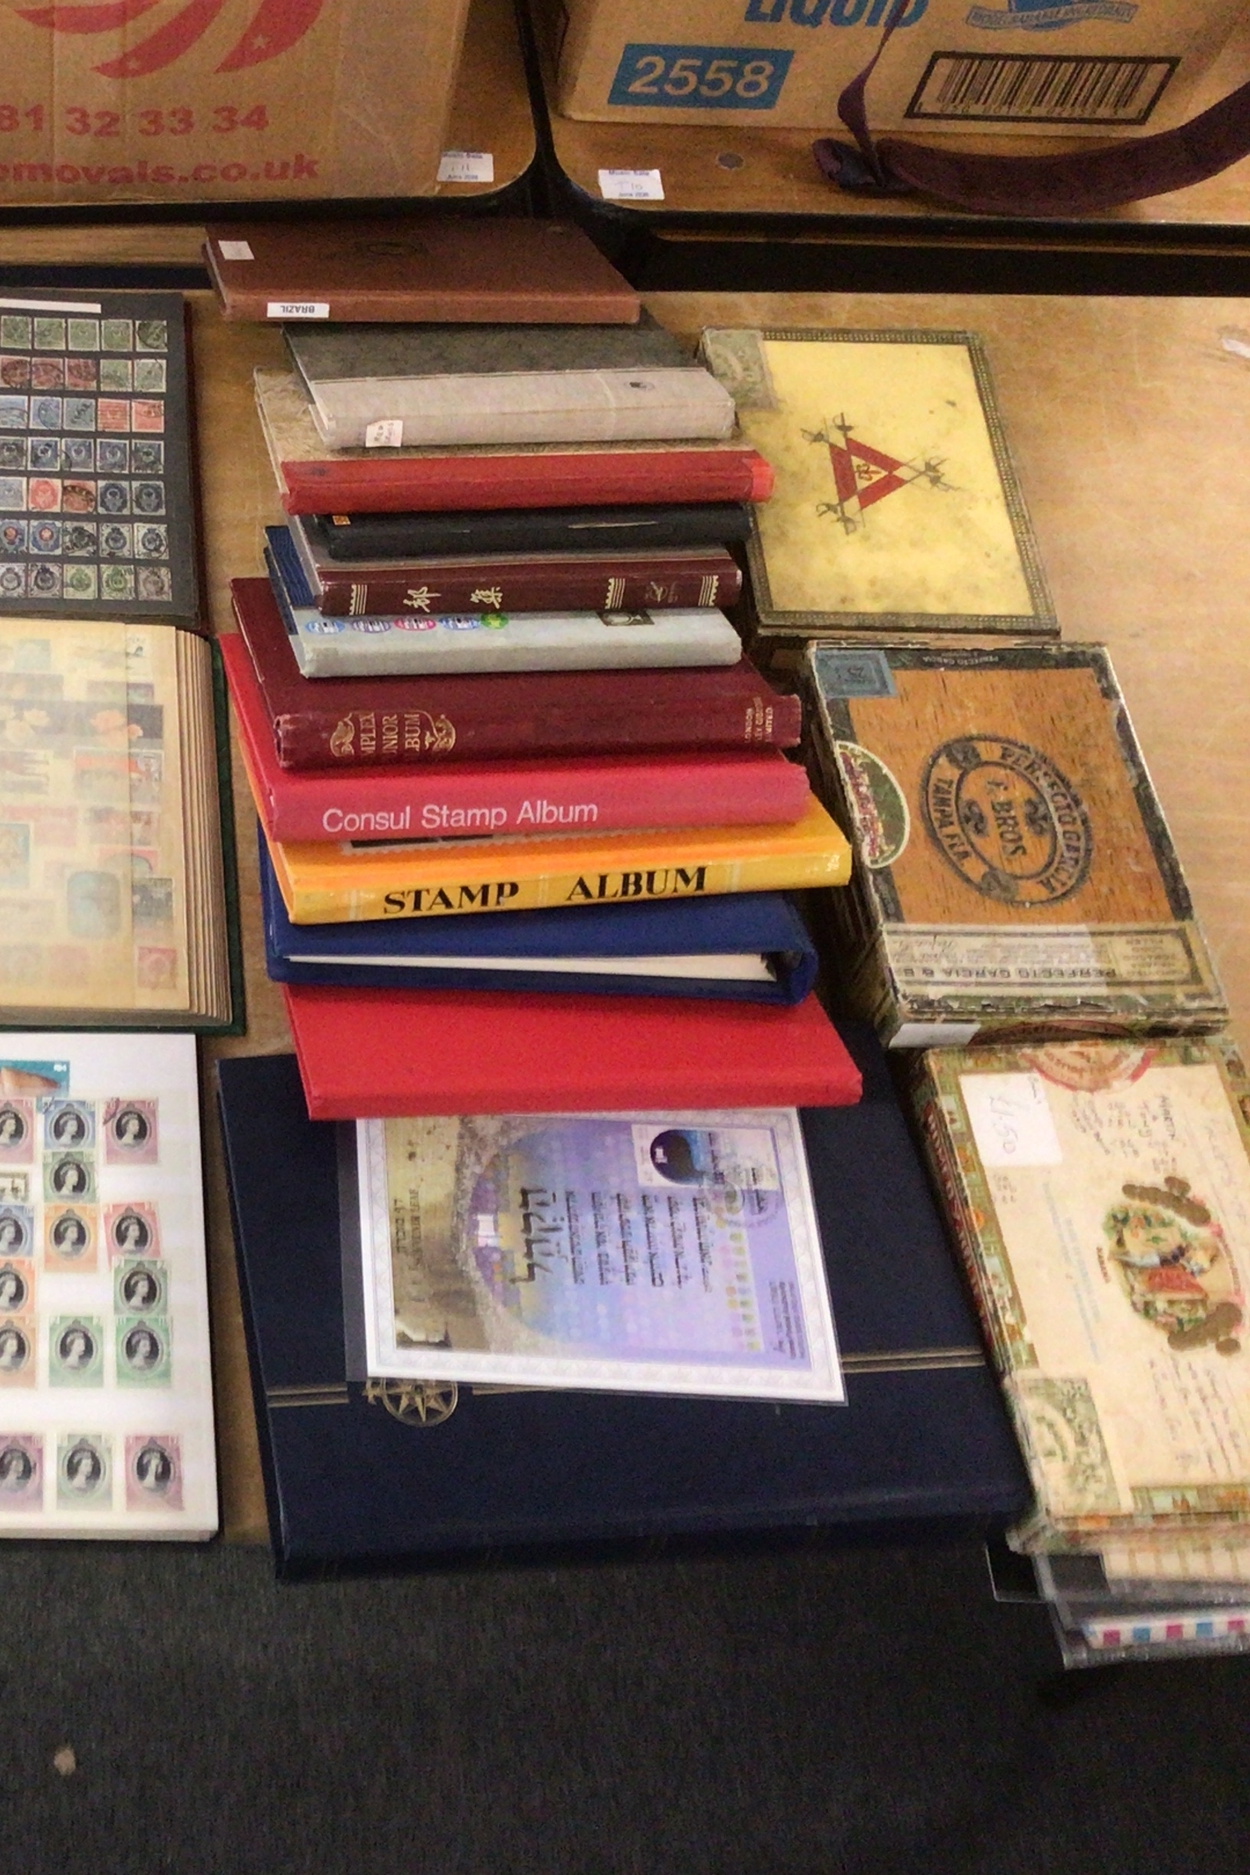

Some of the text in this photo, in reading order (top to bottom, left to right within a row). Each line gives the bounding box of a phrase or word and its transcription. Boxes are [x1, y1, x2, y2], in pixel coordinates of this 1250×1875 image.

[628, 55, 775, 98] 2558
[65, 106, 121, 137] 32
[138, 106, 195, 136] 33
[212, 105, 270, 133] 34
[280, 305, 316, 314] BRAZIL
[322, 799, 599, 833] Consul Stamp Album
[383, 866, 709, 915] STAMP ALBUM
[944, 967, 1012, 979] GARCIA
[1018, 966, 1117, 979] PERFECTO
